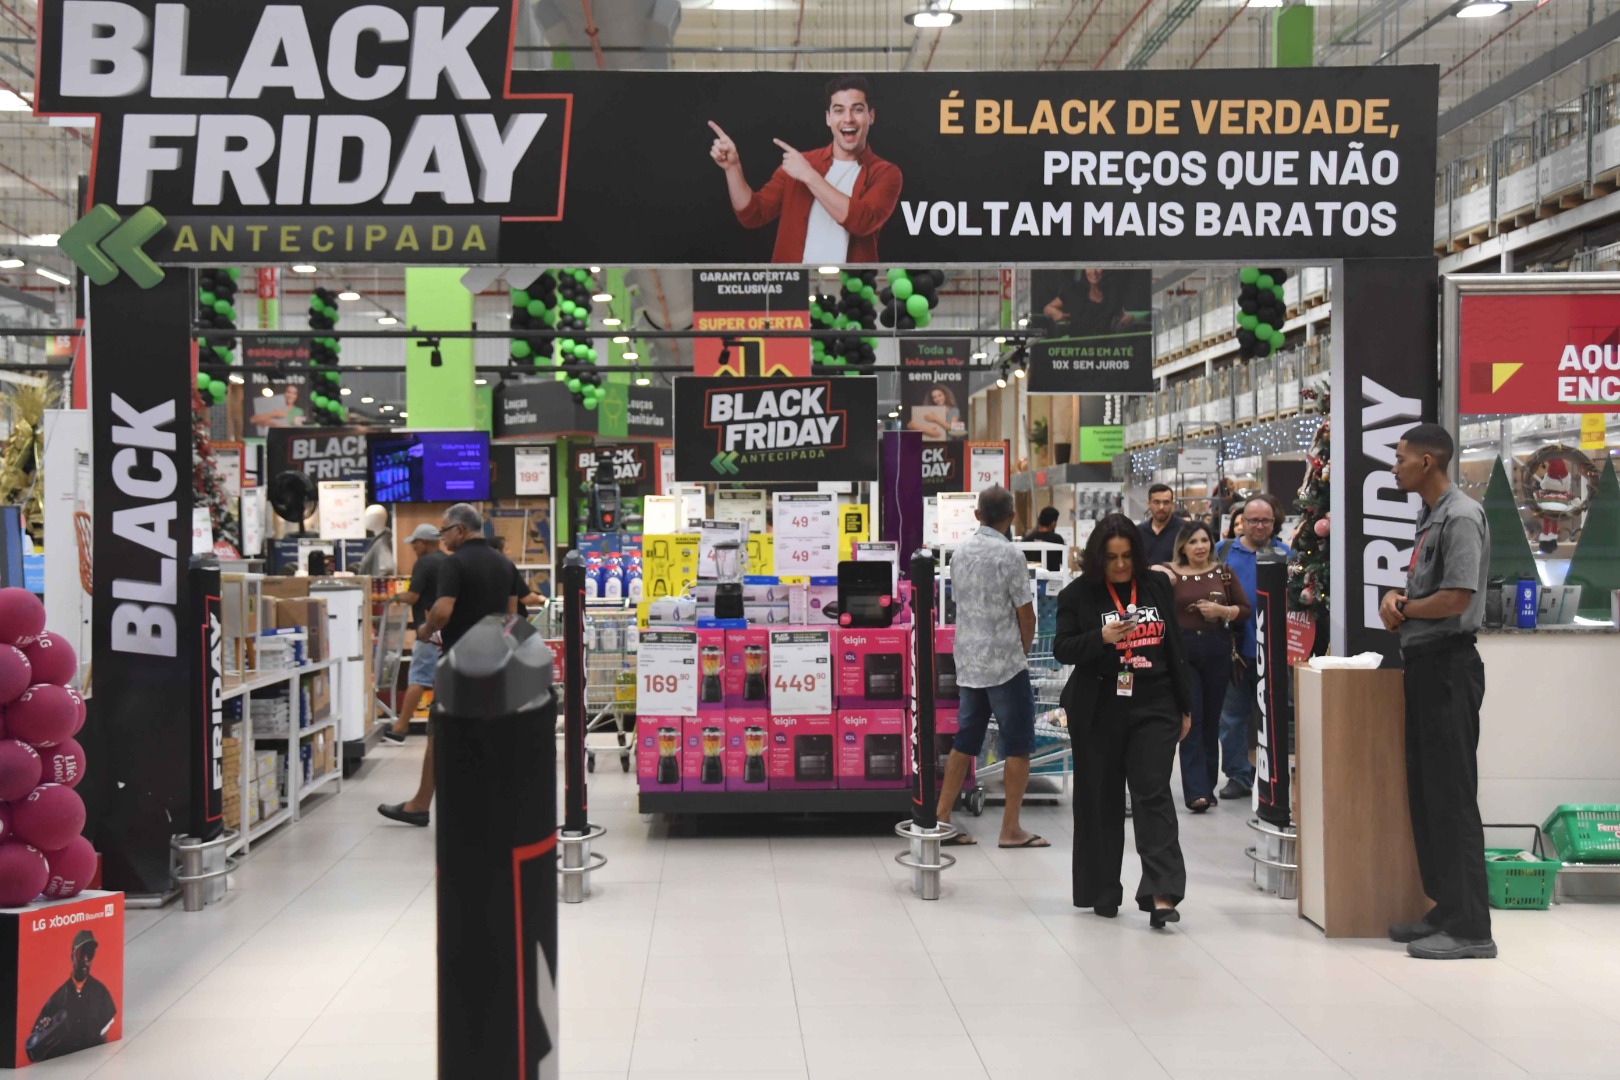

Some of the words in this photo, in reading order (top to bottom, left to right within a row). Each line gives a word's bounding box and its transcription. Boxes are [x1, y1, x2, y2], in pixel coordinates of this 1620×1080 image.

[60, 0, 500, 101] BLACK
[939, 90, 964, 134] É
[975, 99, 1116, 135] BLACK
[1126, 99, 1181, 135] DE
[1191, 98, 1399, 138] VERDADE,
[116, 113, 548, 206] FRIDAY
[1043, 150, 1204, 194] PREÇOS
[1216, 150, 1299, 190] QUE
[1309, 141, 1400, 185] NÃO
[901, 200, 1073, 237] VOLTAM
[1083, 200, 1185, 237] MAIS
[1195, 200, 1397, 237] BARATOS
[172, 224, 487, 253] ANTECIPADA
[700, 271, 751, 281] GARANTA
[752, 271, 800, 281] OFERTAS
[718, 284, 783, 294] EXCLUSIVAS
[698, 318, 747, 330] SUPER
[749, 316, 804, 330] OFERTA
[918, 344, 945, 355] Toda
[1048, 347, 1095, 357] OFERTAS
[1096, 347, 1111, 357] EM
[1112, 345, 1134, 357] ATÉ
[1052, 360, 1069, 370] 10X
[1073, 360, 1095, 370] SEM
[1096, 360, 1130, 370] JUROS
[908, 372, 932, 381] sem
[932, 370, 962, 384] juros
[504, 398, 528, 410] Louças
[710, 386, 826, 423] BLACK
[725, 416, 840, 452] FRIDAY
[578, 449, 635, 469] BLCK
[740, 449, 826, 464] ANTECIPADA
[978, 471, 991, 482] 79
[111, 392, 178, 658] BLACK
[792, 516, 809, 528] 49
[792, 550, 809, 562] 49
[843, 635, 867, 647] elgin
[644, 674, 678, 693] 169
[774, 674, 816, 692] 449
[211, 611, 223, 791] FRIDAY
[1256, 608, 1270, 785] BLACK
[773, 716, 797, 728] elgin
[843, 716, 867, 727] elgin
[33, 919, 46, 932] LG
[49, 911, 85, 928] xboom
